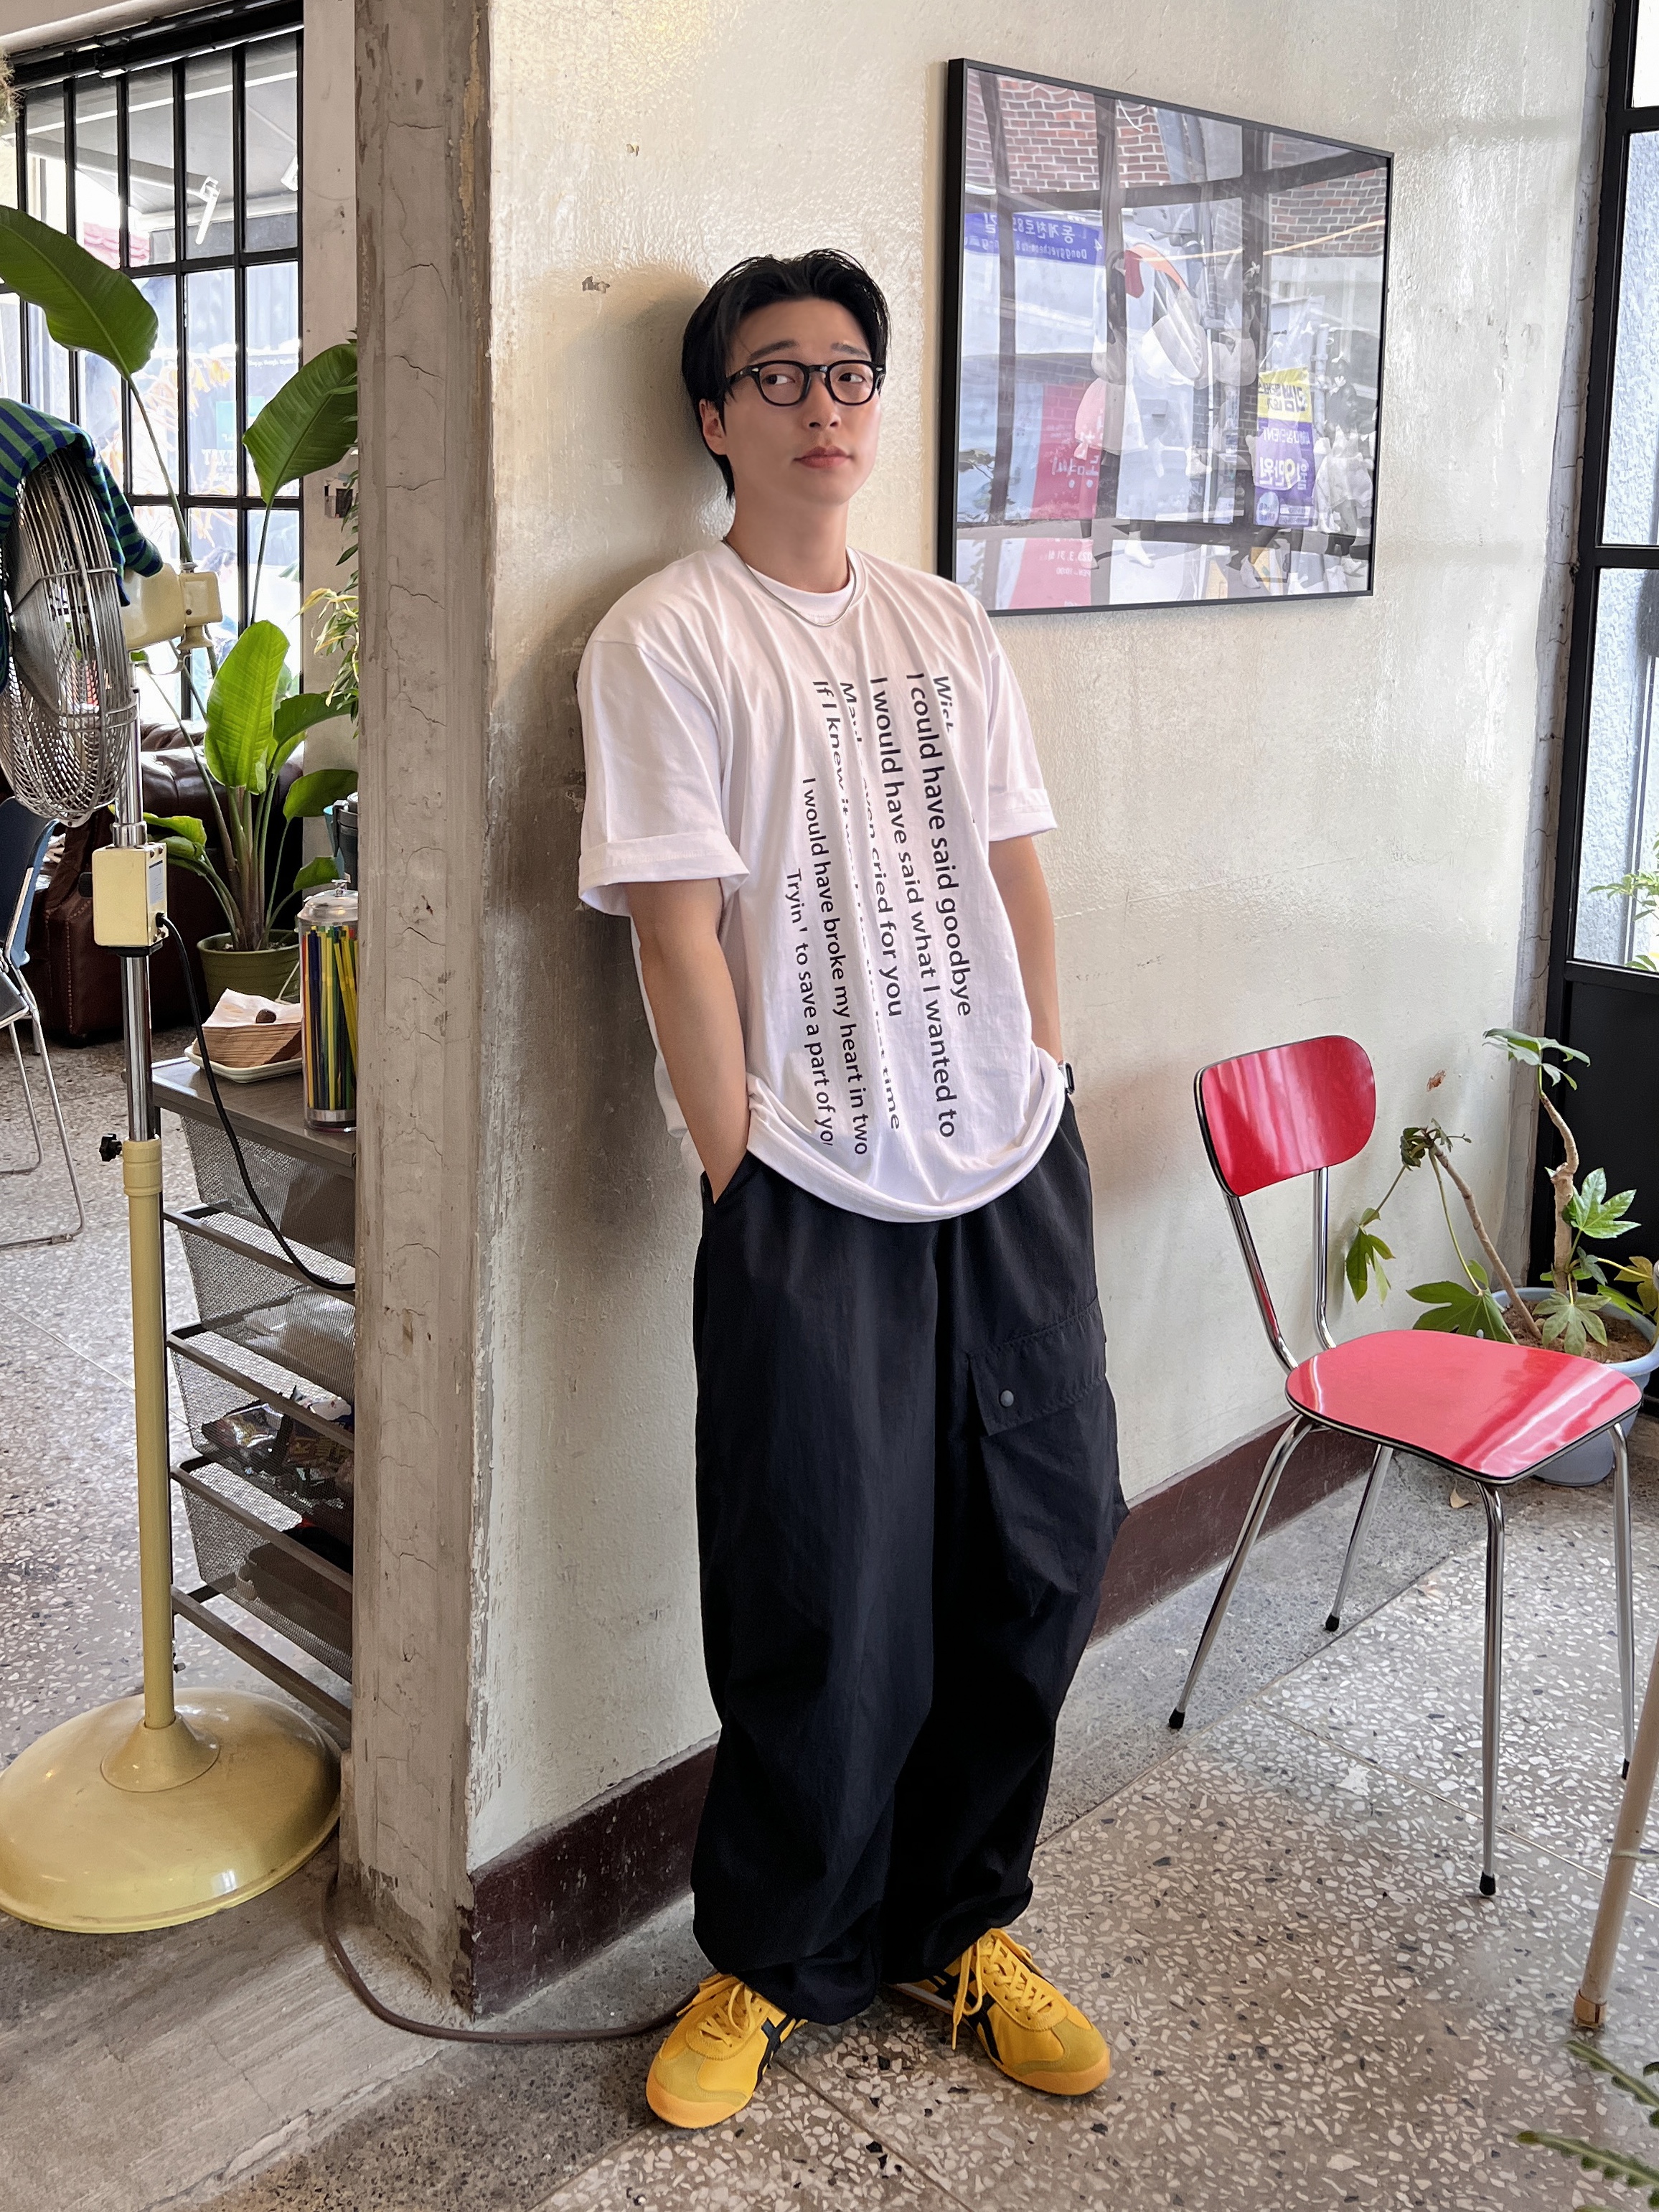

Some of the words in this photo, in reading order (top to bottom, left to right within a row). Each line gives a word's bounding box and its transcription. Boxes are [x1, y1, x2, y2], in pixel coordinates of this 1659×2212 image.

[813, 682, 834, 697] If
[873, 690, 903, 773] would
[911, 687, 943, 759] could
[804, 789, 829, 856] would
[884, 782, 906, 843] have
[923, 766, 945, 829] have
[814, 861, 833, 912] have
[873, 848, 893, 912] cried
[898, 852, 924, 904] said
[931, 838, 959, 890] said
[796, 943, 808, 965] to
[824, 918, 846, 979] broke
[880, 921, 896, 958] for
[911, 911, 936, 978] what
[936, 899, 970, 1016] goodbye
[799, 972, 816, 1018] save
[832, 986, 850, 1018] my
[879, 966, 901, 1016] you
[807, 1024, 819, 1036] a
[840, 1023, 863, 1082] heart
[926, 999, 957, 1102] wanted
[804, 1042, 830, 1086] part
[817, 1092, 836, 1112] of
[850, 1088, 866, 1108] in
[939, 1109, 957, 1137] to
[853, 1114, 868, 1154] two
